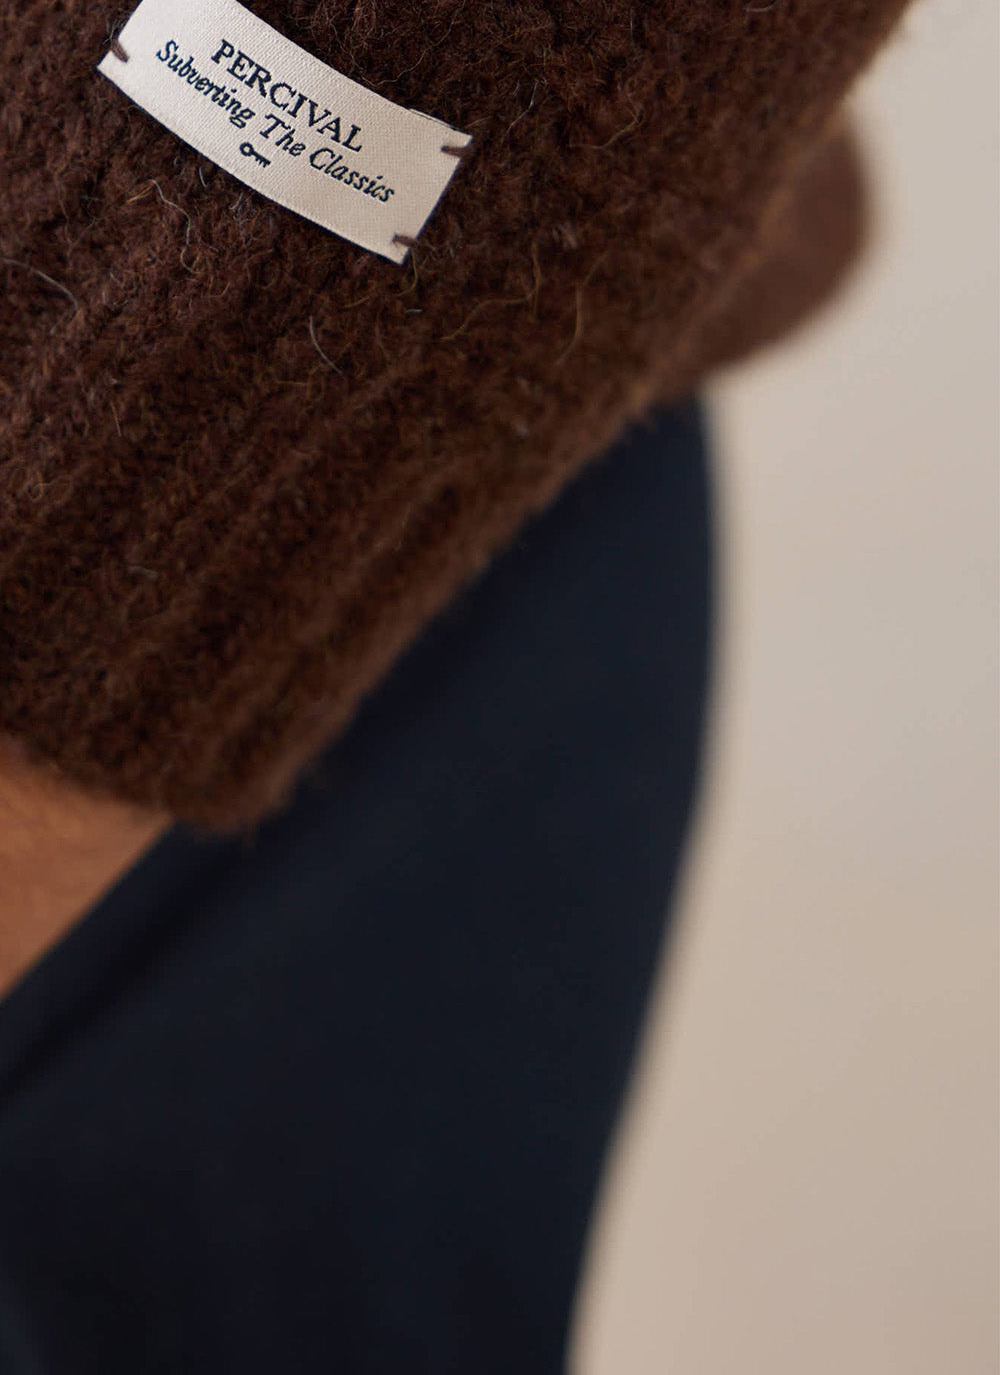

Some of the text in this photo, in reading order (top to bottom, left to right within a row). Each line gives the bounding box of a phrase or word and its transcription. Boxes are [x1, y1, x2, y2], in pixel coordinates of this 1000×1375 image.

[155, 39, 396, 203] Subverting The Classics
[211, 39, 363, 152] PERCIVAL
